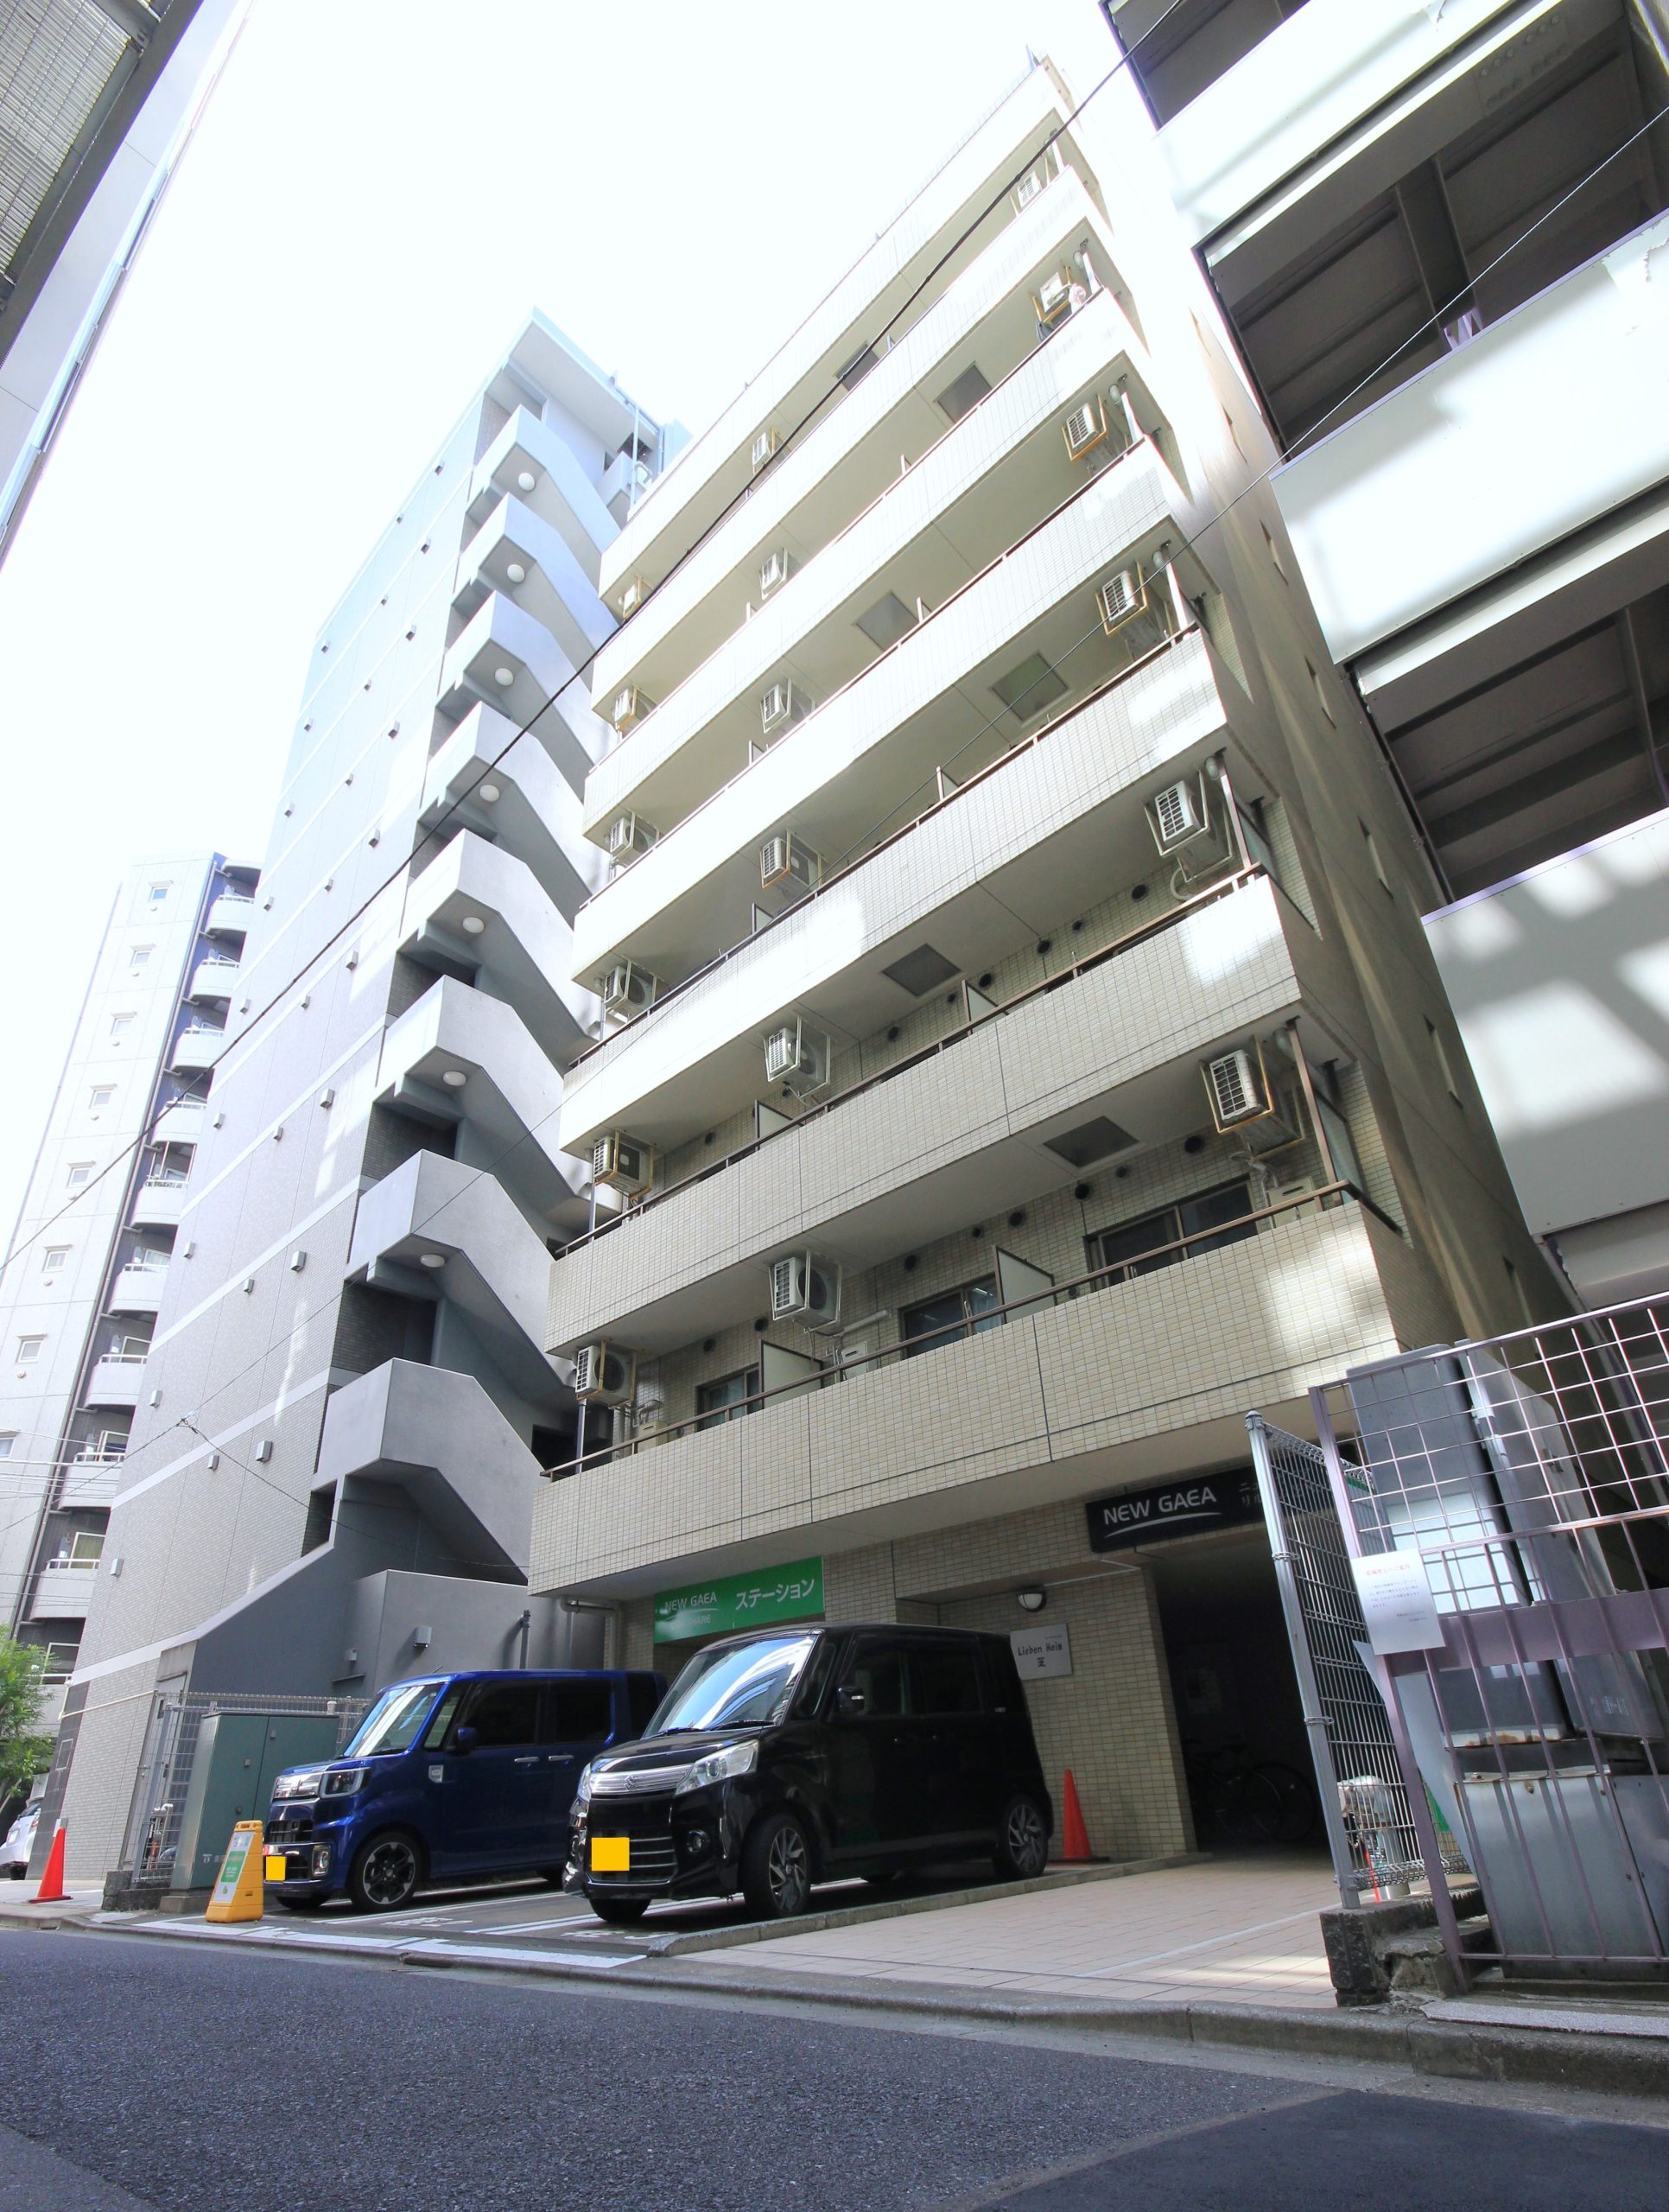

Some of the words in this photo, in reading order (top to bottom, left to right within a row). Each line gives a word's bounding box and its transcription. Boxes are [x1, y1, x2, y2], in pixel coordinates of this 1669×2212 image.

[1103, 1499, 1150, 1525] NEW
[1158, 1486, 1217, 1513] GAEA
[664, 1597, 688, 1612] NEW
[690, 1592, 718, 1606] GAEA
[735, 1579, 815, 1611] ステーション
[1018, 1645, 1043, 1656] Lieben
